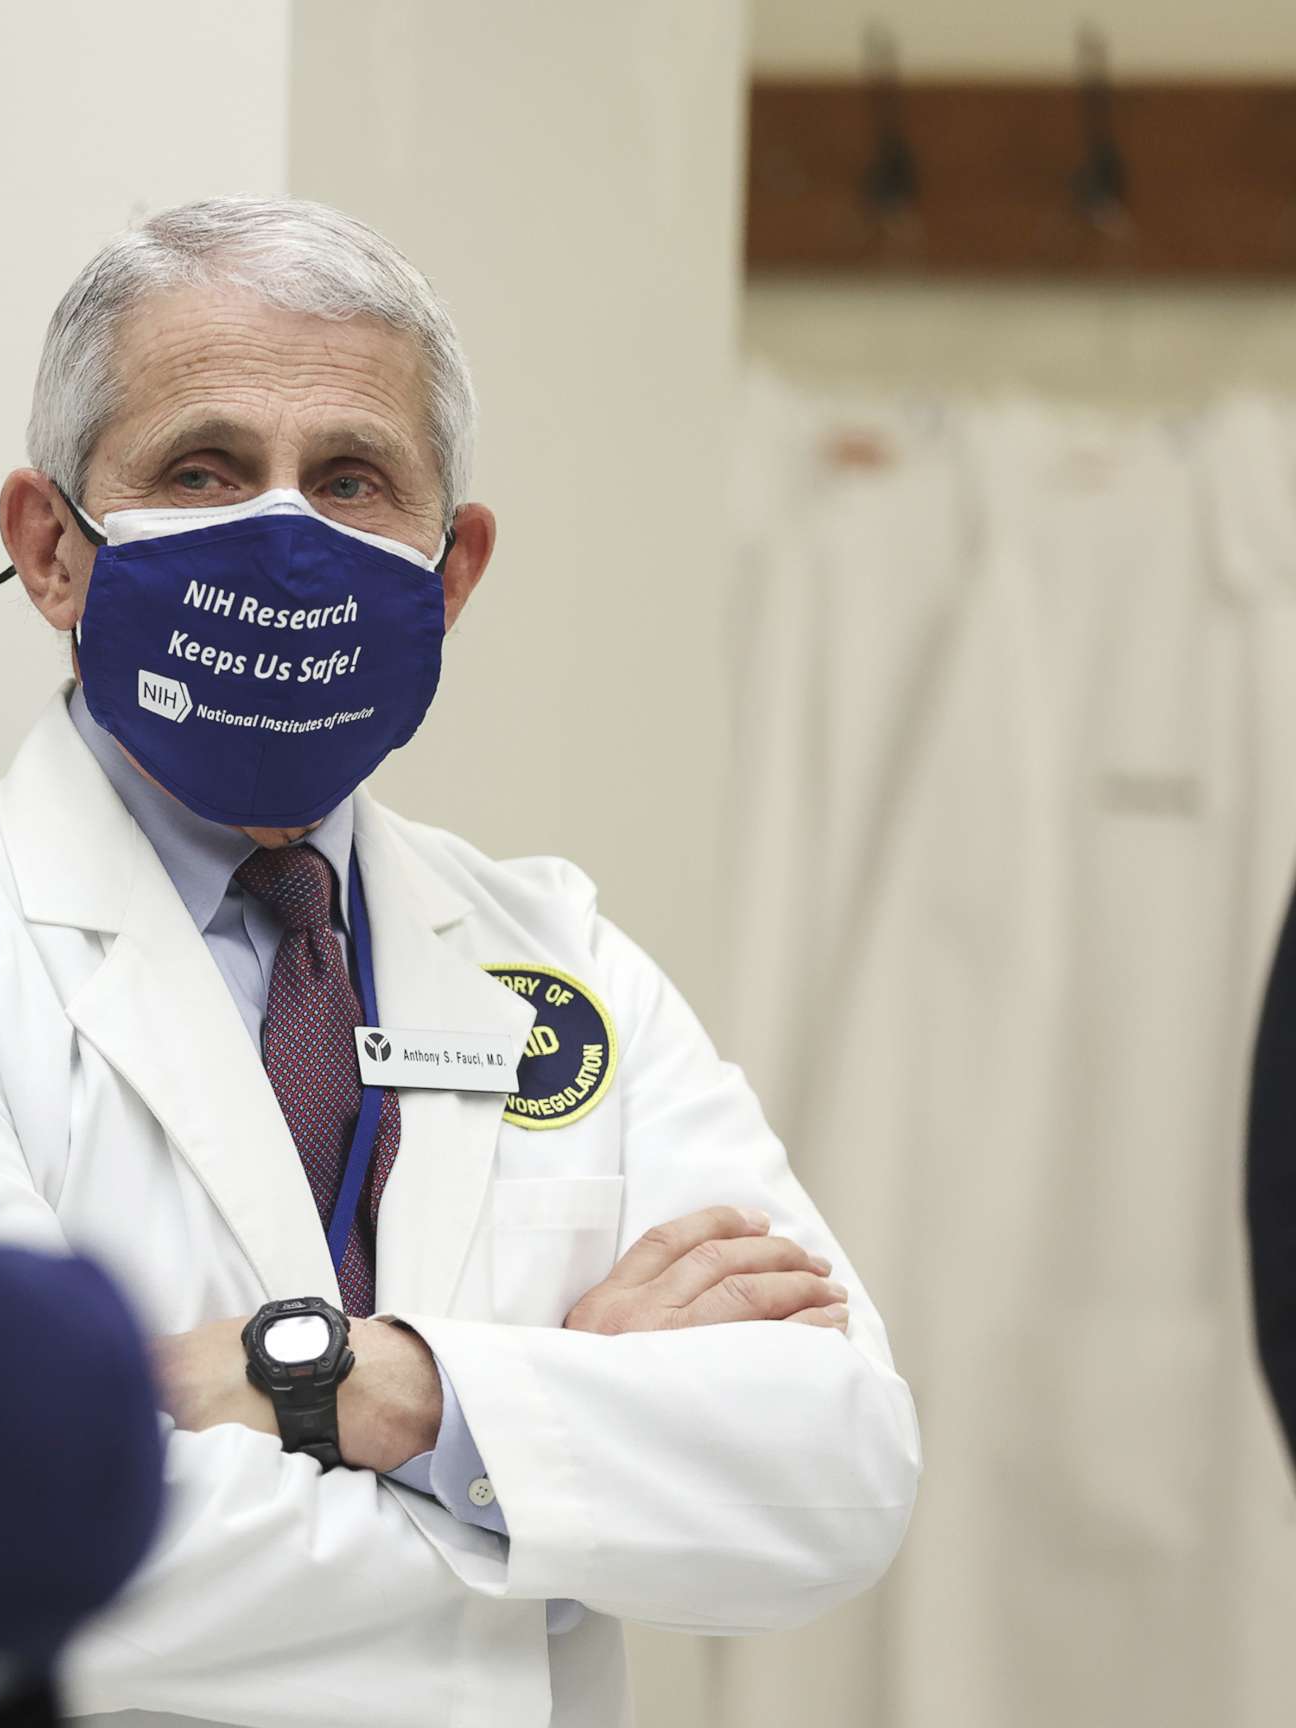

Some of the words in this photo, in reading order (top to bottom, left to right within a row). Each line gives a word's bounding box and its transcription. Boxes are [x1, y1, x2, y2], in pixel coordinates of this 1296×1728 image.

[183, 580, 235, 617] NIH
[238, 595, 358, 630] Research
[167, 630, 247, 676] Keeps
[254, 653, 292, 681] Us
[297, 646, 362, 684] Safe!
[143, 681, 177, 710] NIH
[196, 704, 259, 728] National
[260, 715, 323, 733] Institutes
[324, 713, 337, 730] of
[337, 706, 375, 724] Health
[545, 984, 574, 1006] OF
[403, 1049, 440, 1066] Anthony
[443, 1050, 453, 1064] S.
[456, 1051, 484, 1067] Fauci,
[486, 1053, 507, 1066] M.D.
